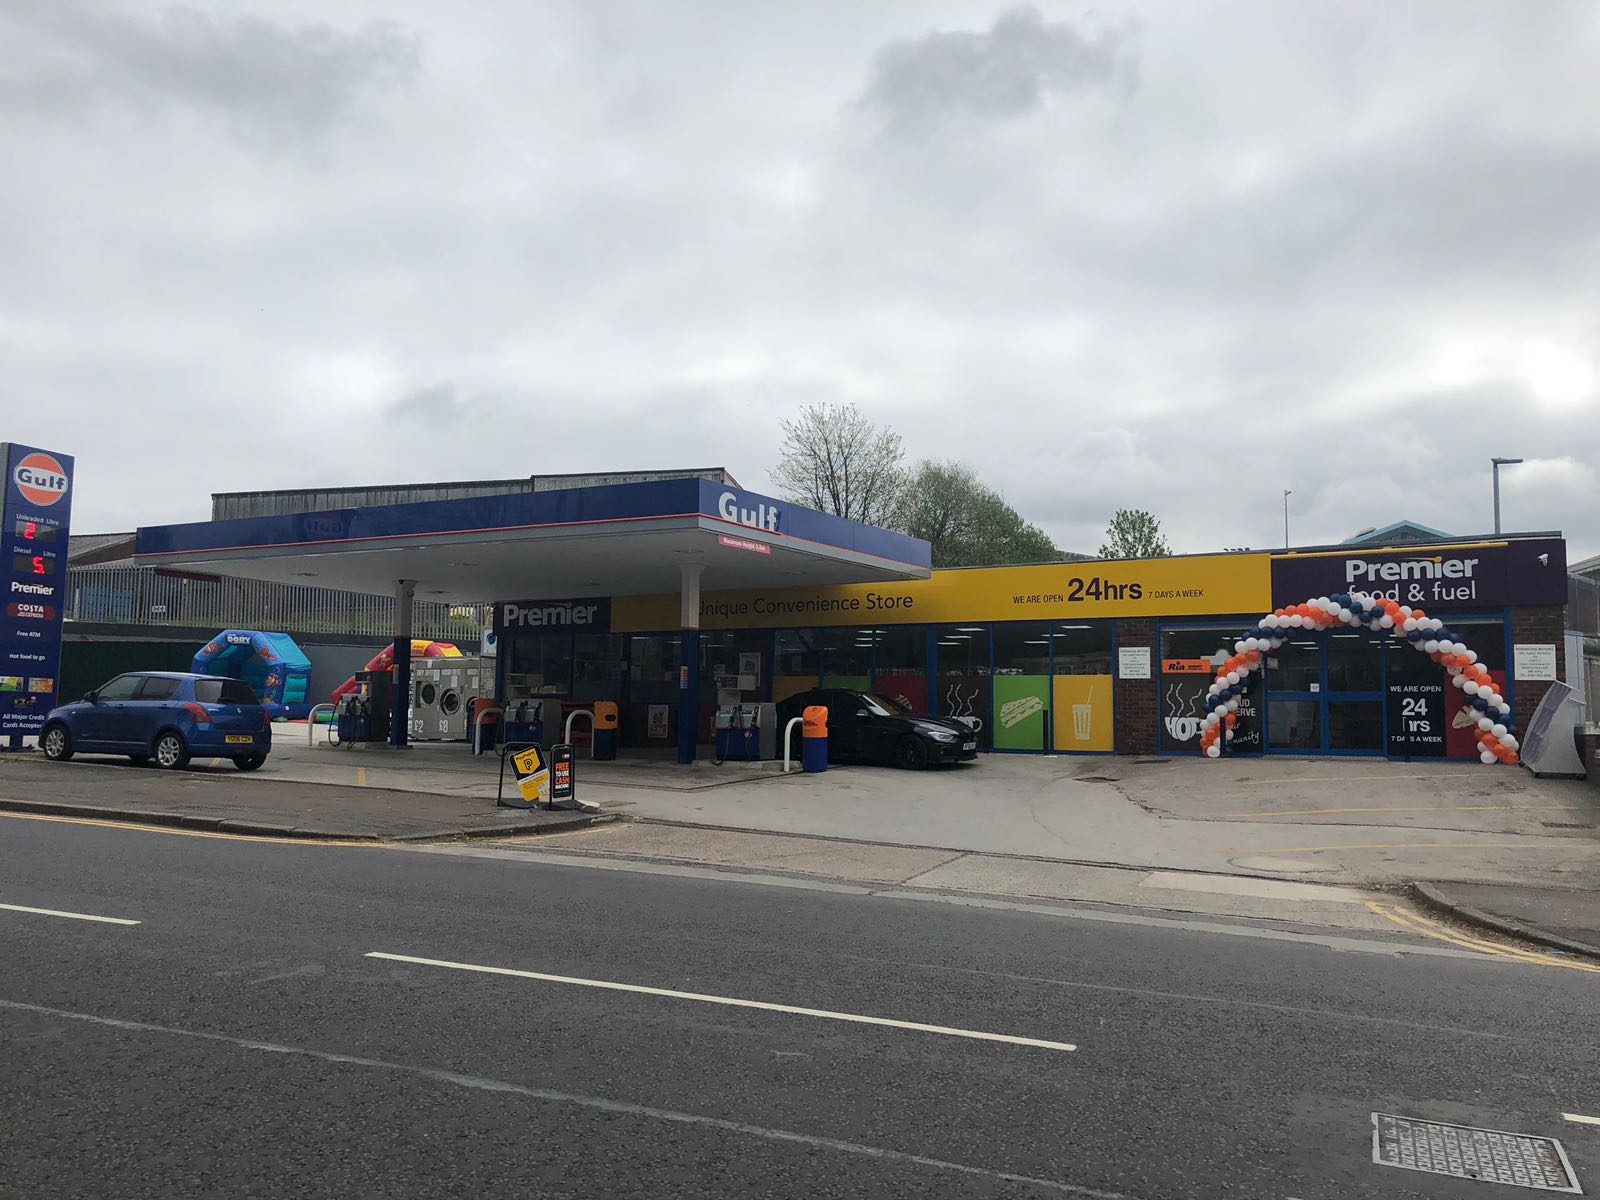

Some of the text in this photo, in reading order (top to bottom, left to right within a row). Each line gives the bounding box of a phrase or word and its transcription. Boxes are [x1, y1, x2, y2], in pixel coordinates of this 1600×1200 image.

[17, 468, 65, 490] Gulf
[718, 491, 779, 532] Gulf
[16, 513, 60, 526] Unleaded Litre
[13, 546, 32, 555] Diesel
[1345, 556, 1479, 582] Premier
[11, 581, 54, 596] Premier
[1013, 577, 1204, 604] WE ARE OPEN 24hrs 7 DAYS A WEEK
[1407, 583, 1426, 602] &
[1432, 580, 1477, 600] fuel
[17, 604, 44, 613] COSTA
[753, 595, 860, 615] Convenience
[866, 592, 914, 610] Store
[503, 602, 598, 627] Premier
[1168, 661, 1185, 671] Ria
[1236, 707, 1257, 717] ERVE
[1402, 697, 1428, 716] 24
[11, 713, 28, 721] Major
[414, 719, 424, 733] £2
[439, 719, 449, 733] £8
[1164, 716, 1200, 741] HOT
[555, 761, 570, 772] FREE
[555, 776, 570, 785] CASH
